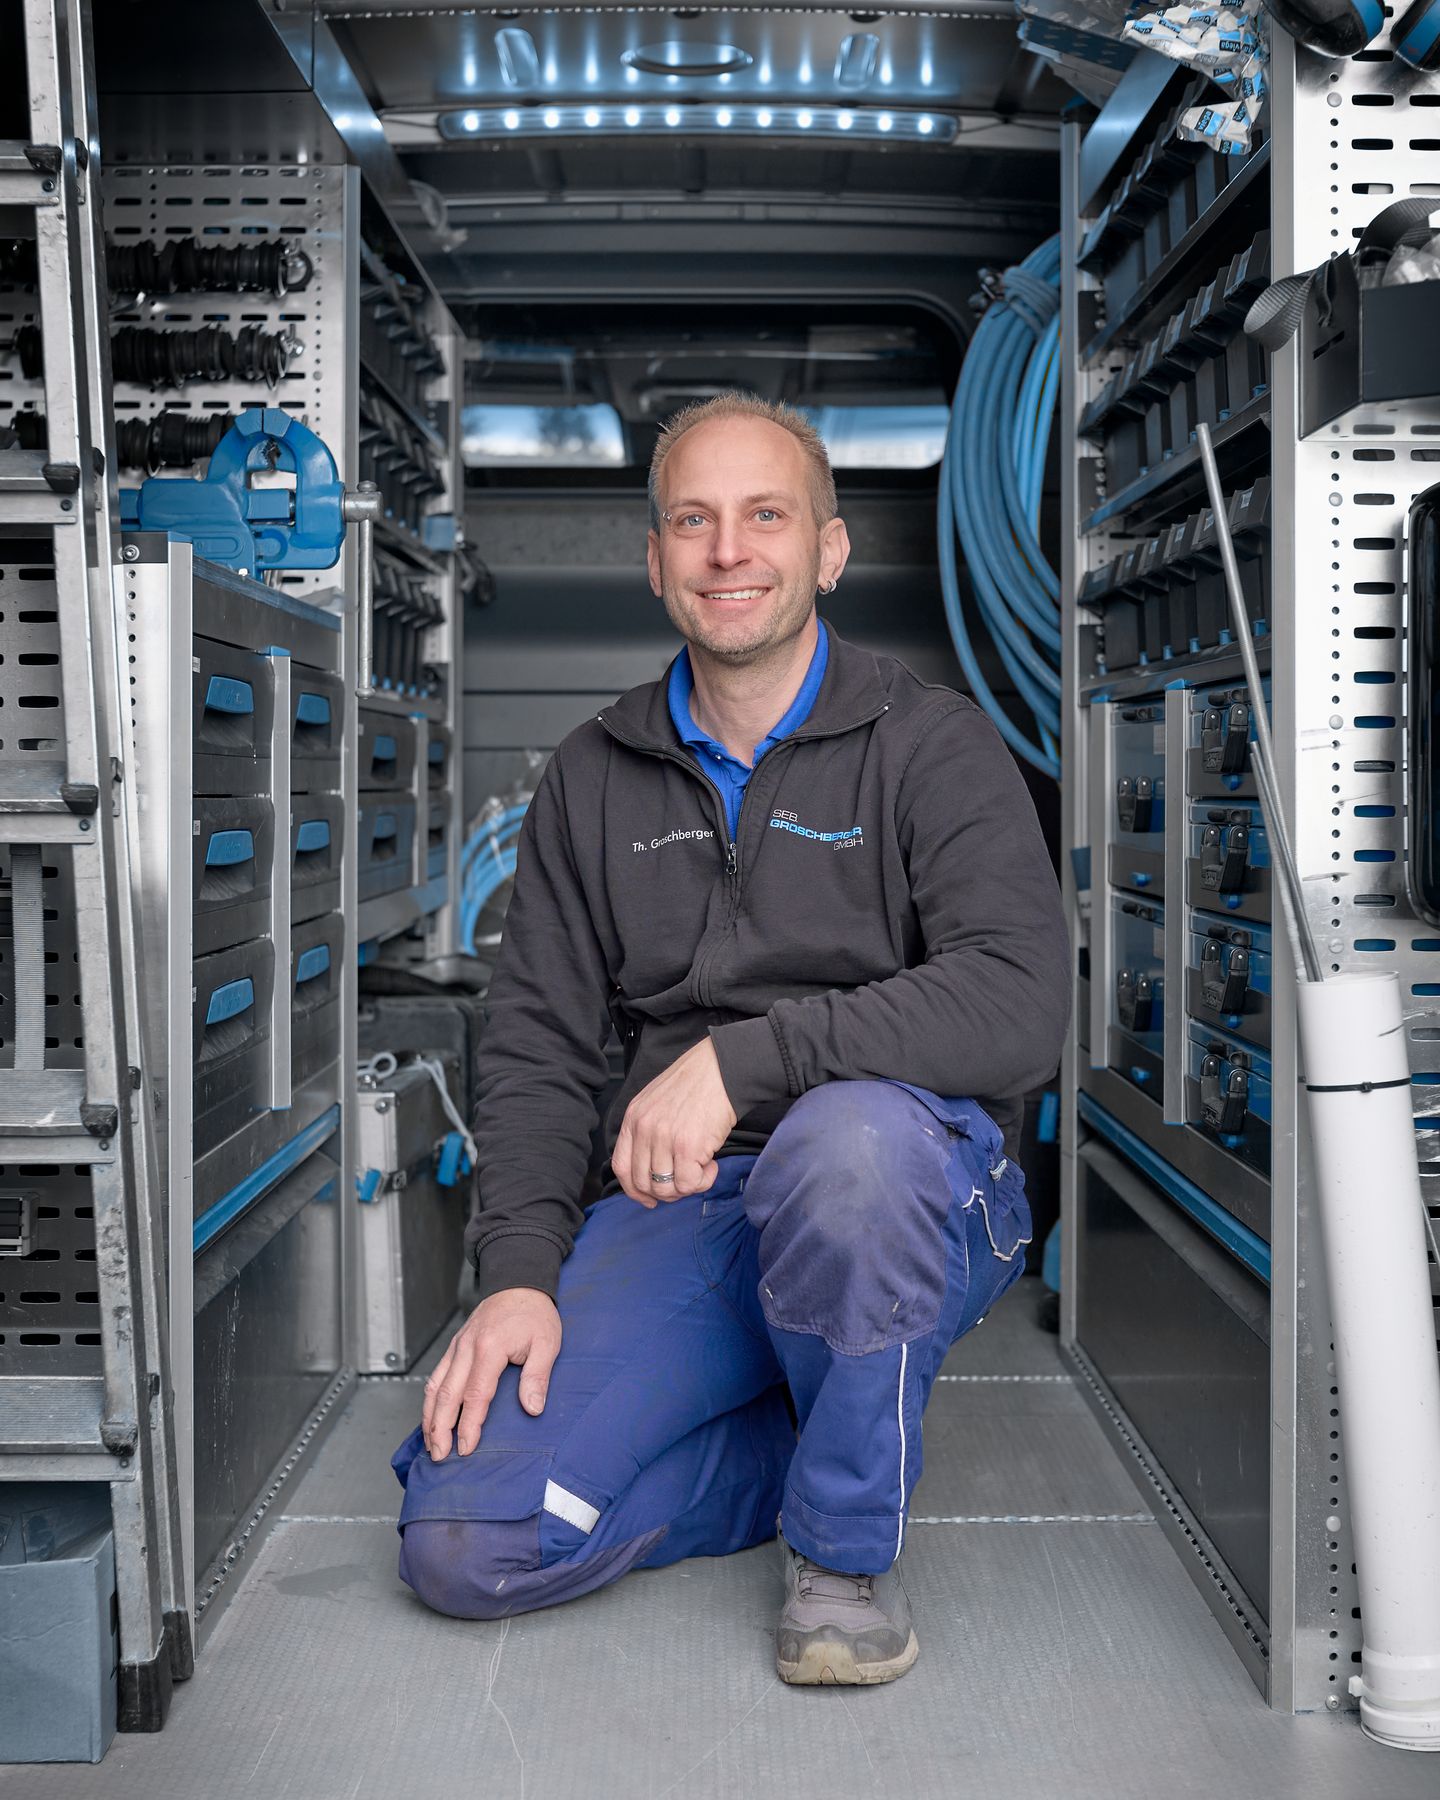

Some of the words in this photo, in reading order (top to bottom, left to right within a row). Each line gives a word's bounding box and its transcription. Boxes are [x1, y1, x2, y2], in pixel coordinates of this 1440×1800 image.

[1221, 40, 1241, 52] viega
[1198, 110, 1212, 130] viega
[632, 841, 648, 853] Th.
[650, 828, 715, 849] Groschberger
[833, 837, 864, 851] GMBH
